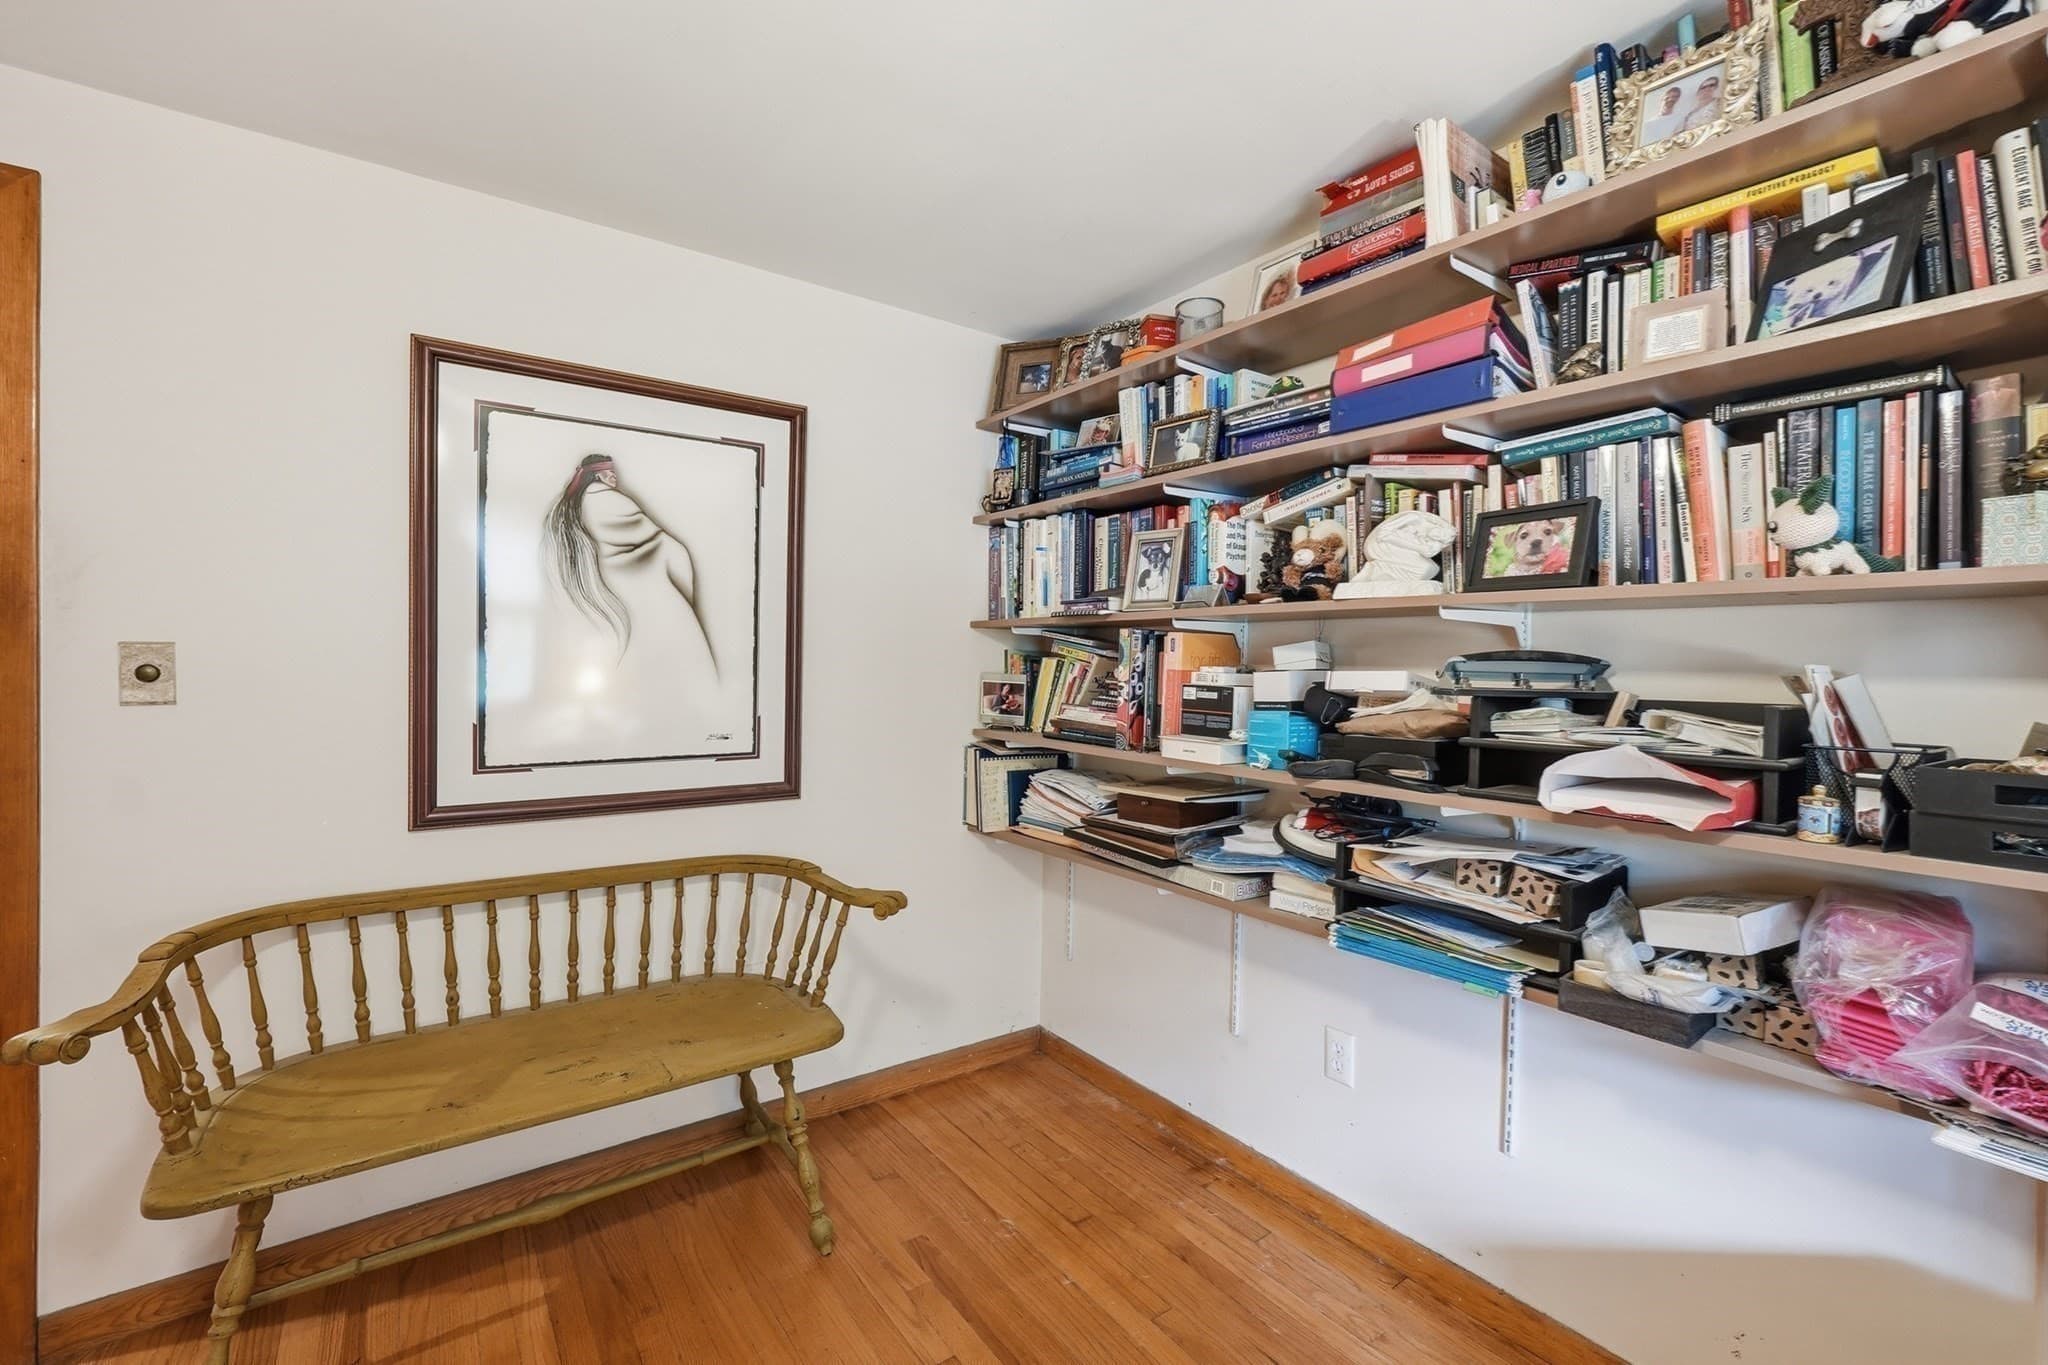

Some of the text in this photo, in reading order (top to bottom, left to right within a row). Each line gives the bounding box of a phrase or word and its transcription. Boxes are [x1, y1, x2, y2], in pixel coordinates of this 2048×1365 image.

[2011, 146, 2028, 188] ELOQUENT
[1363, 174, 1390, 193] LOVE
[1745, 160, 1836, 199] FUGITIVE PEDAGOGY
[2015, 188, 2032, 210] RAGE
[2020, 216, 2040, 256] BRITTNEY
[1590, 302, 1599, 322] WHITE
[1589, 324, 1599, 341] RAGE
[1766, 392, 1822, 408] PERSPECTIVES
[1838, 383, 1868, 396] EATING
[1869, 375, 1919, 390] DISORDERS
[1862, 431, 1874, 449] THE
[1740, 452, 1751, 470] The
[1862, 453, 1875, 490] FEMALE
[1573, 465, 1581, 500] KATE MILLE
[1679, 504, 1691, 542] Bondage
[1741, 506, 1753, 523] Sex
[1624, 526, 1632, 545] Butler
[1233, 543, 1246, 551] Grou
[1623, 547, 1632, 569] Reader
